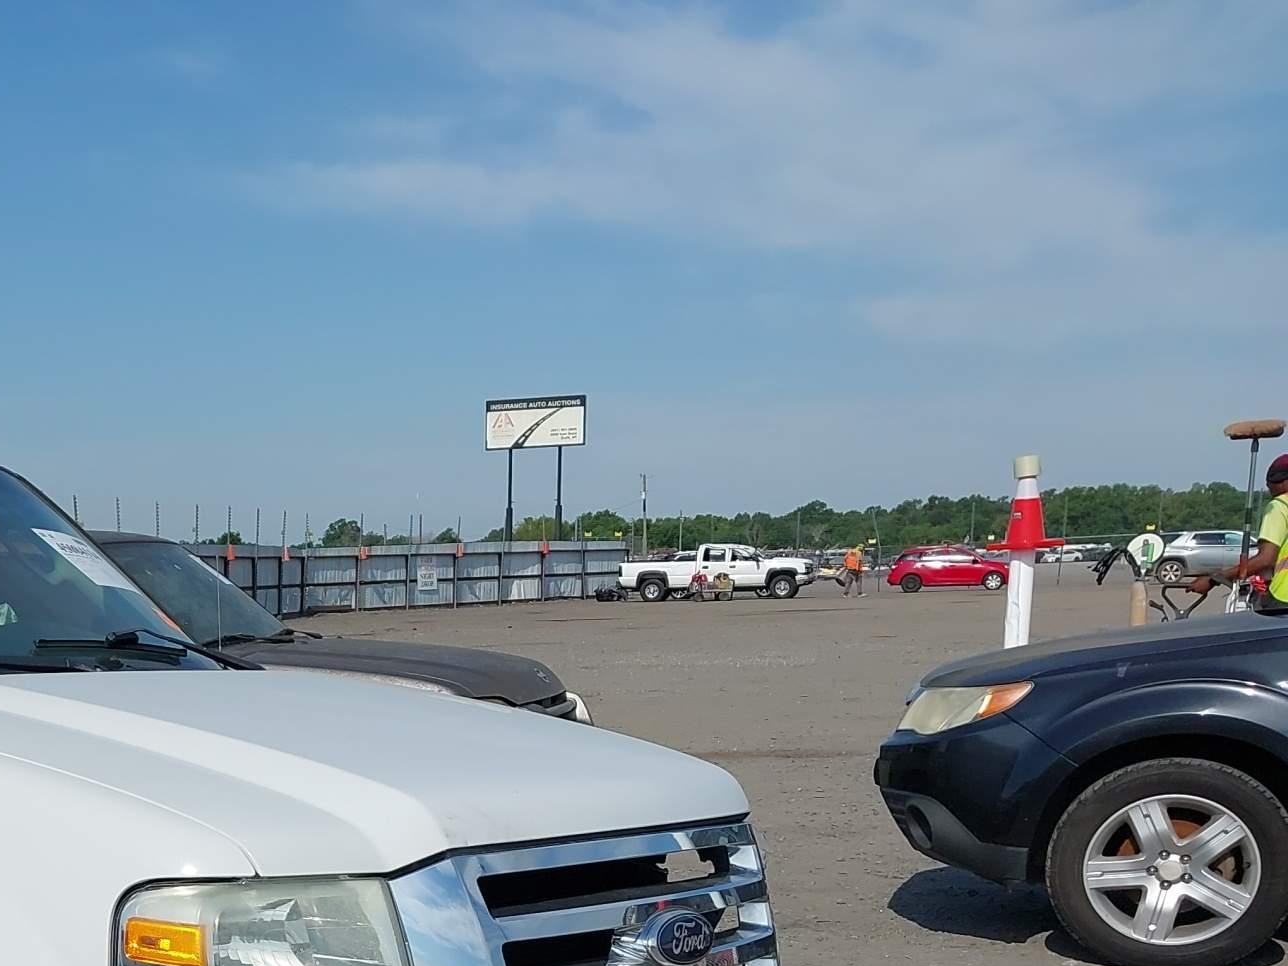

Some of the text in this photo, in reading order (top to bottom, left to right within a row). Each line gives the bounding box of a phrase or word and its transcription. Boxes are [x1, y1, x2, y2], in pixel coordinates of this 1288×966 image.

[490, 399, 581, 410] INSURANCE AUTO AUCTIONS
[672, 921, 705, 955] Ford
